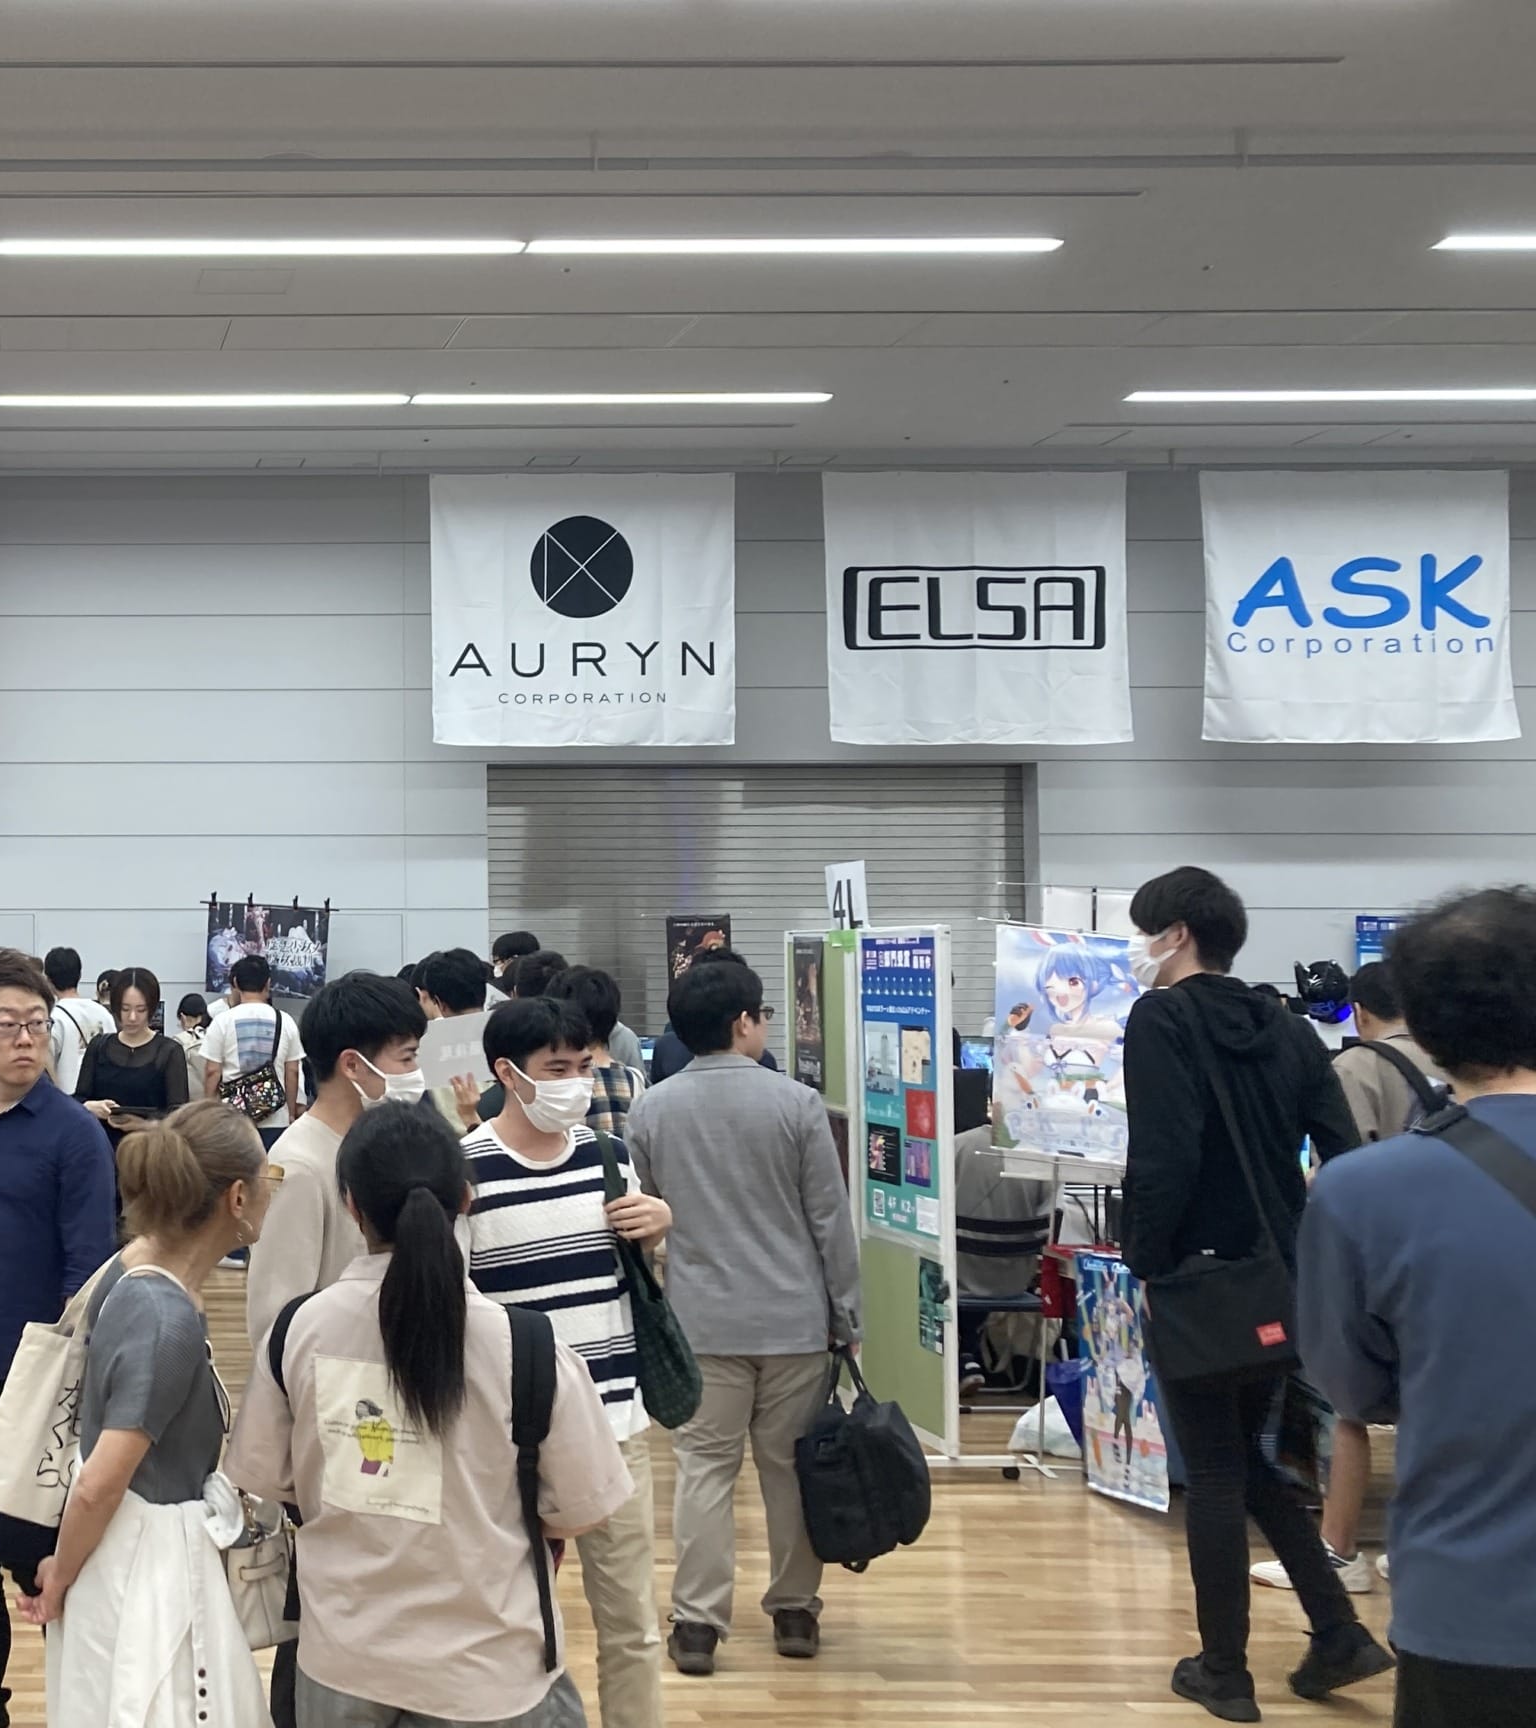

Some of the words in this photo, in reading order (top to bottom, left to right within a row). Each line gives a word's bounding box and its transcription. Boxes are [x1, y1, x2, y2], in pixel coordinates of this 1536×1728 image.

[868, 576, 1086, 641] ELSA
[1232, 553, 1490, 631] ASK
[449, 640, 716, 678] AURYN
[1227, 632, 1495, 658] Corporation
[498, 692, 667, 704] CORPORATION
[833, 879, 863, 930] 4L
